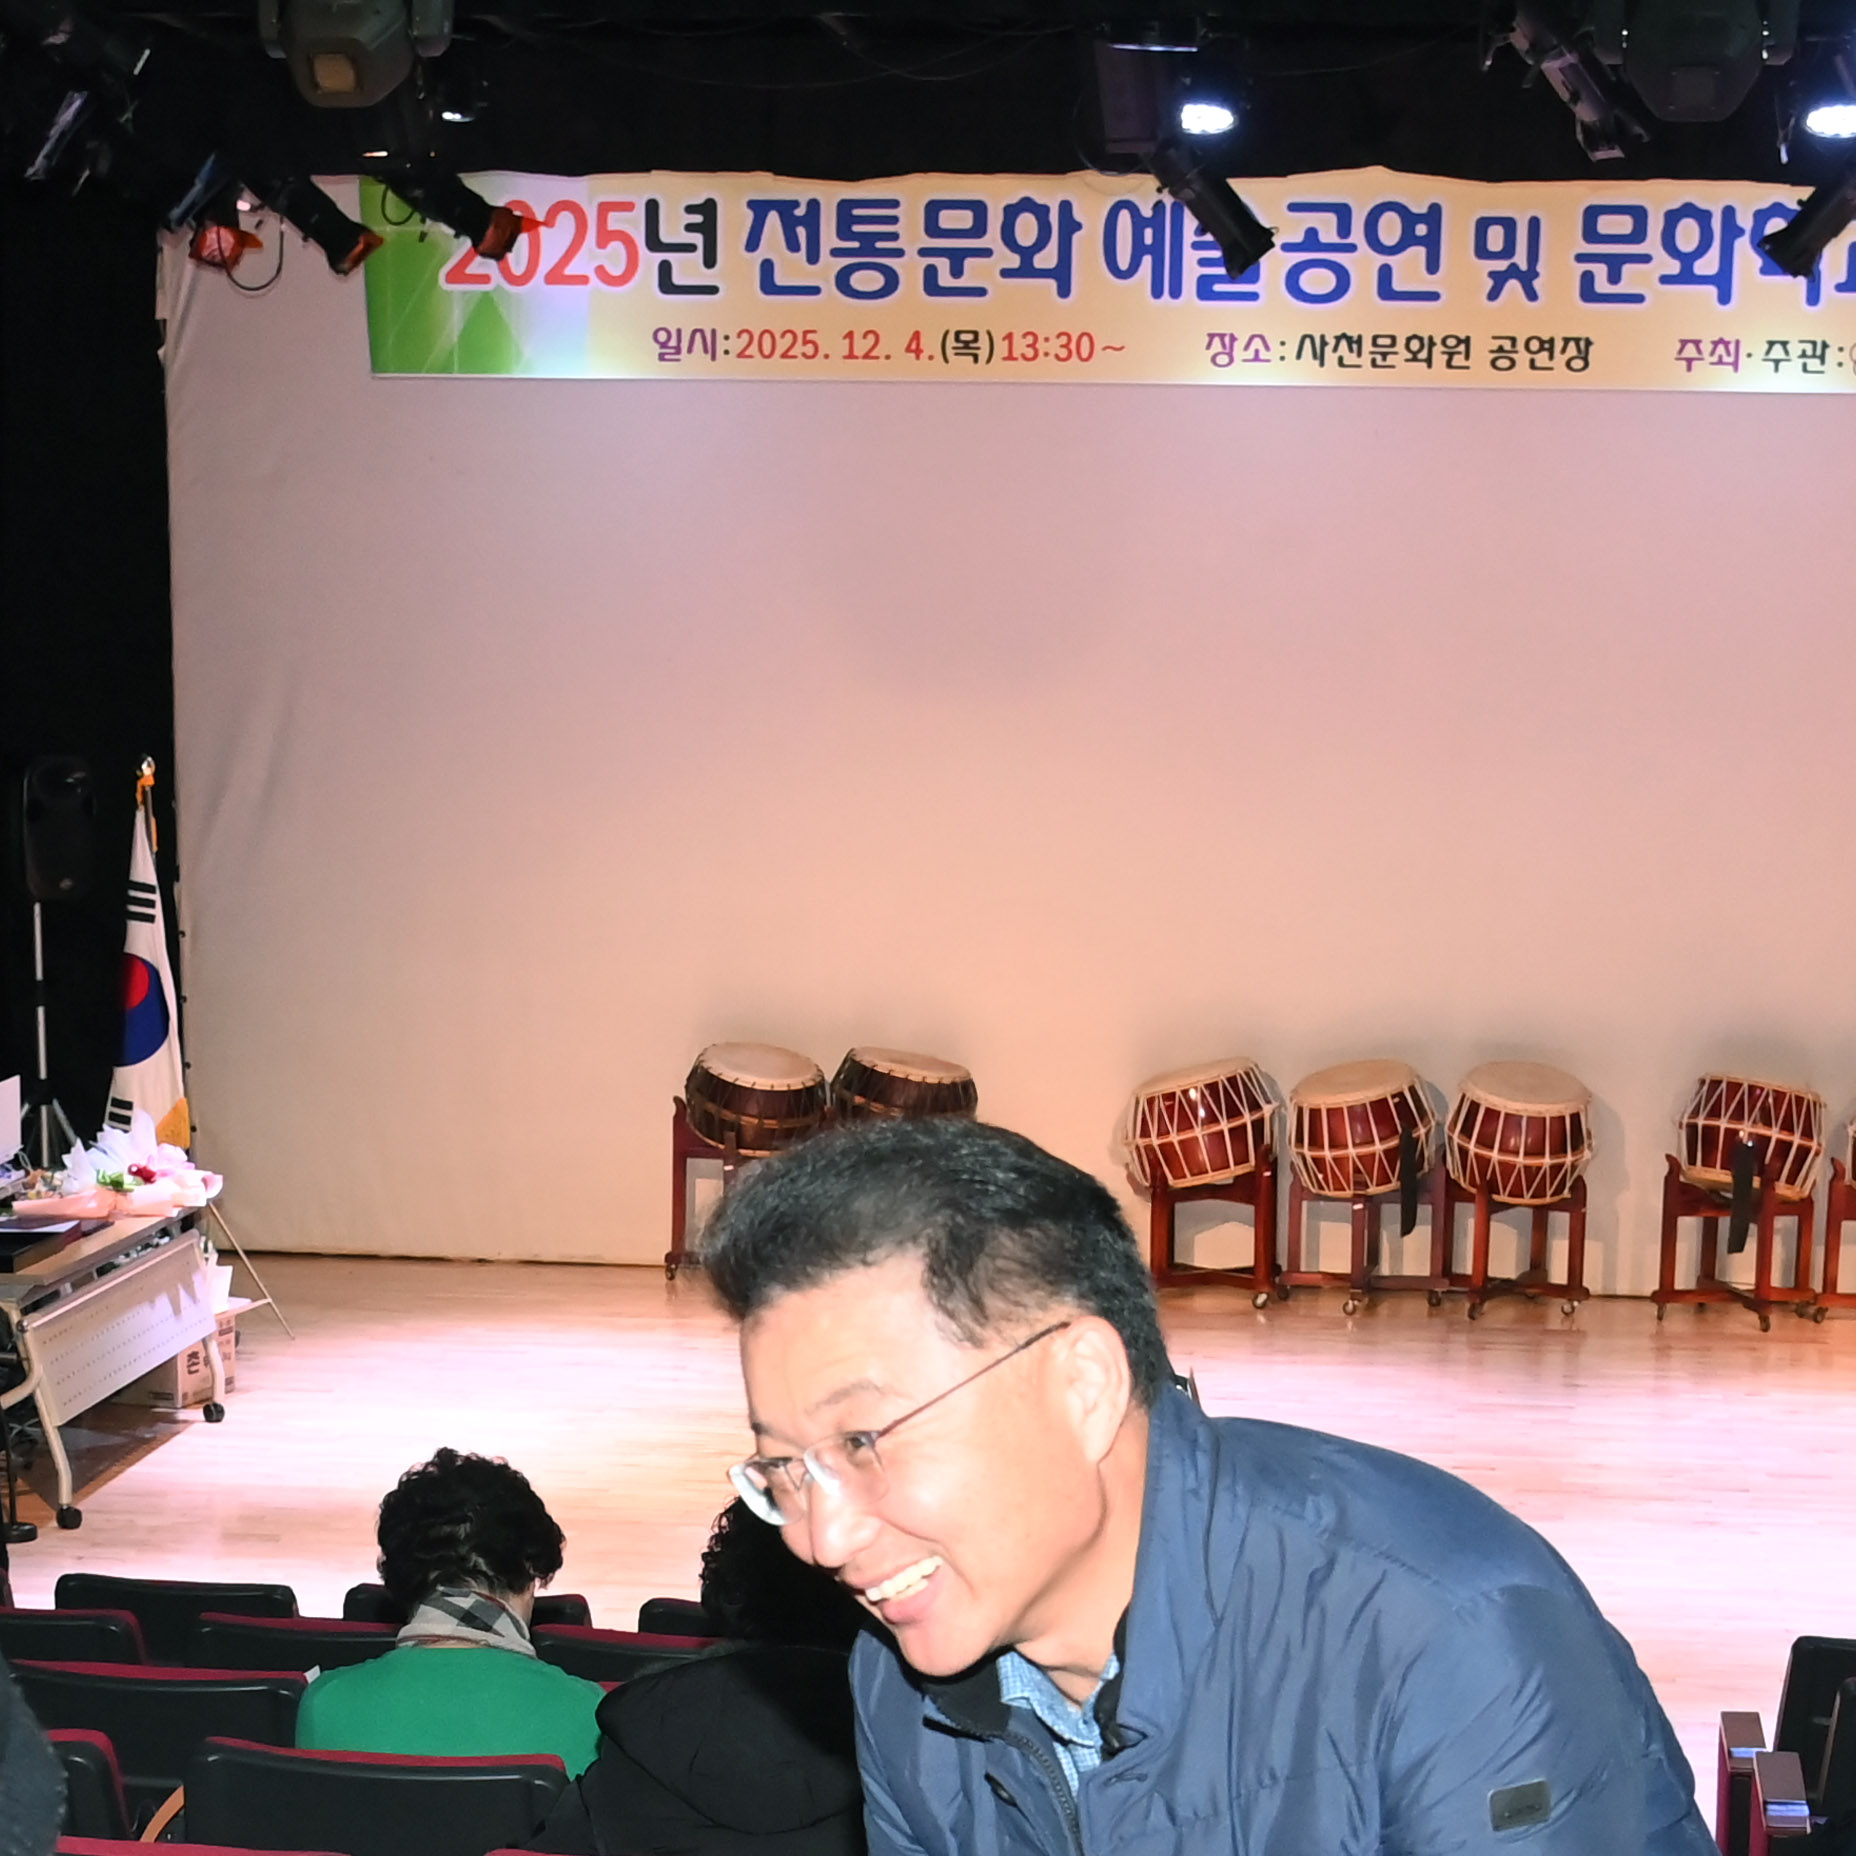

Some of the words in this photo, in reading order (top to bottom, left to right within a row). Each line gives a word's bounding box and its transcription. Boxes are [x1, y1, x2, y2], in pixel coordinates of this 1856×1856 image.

[745, 196, 1083, 301] 전통문화
[1474, 214, 1542, 305] 및
[1489, 332, 1593, 373] 공연장
